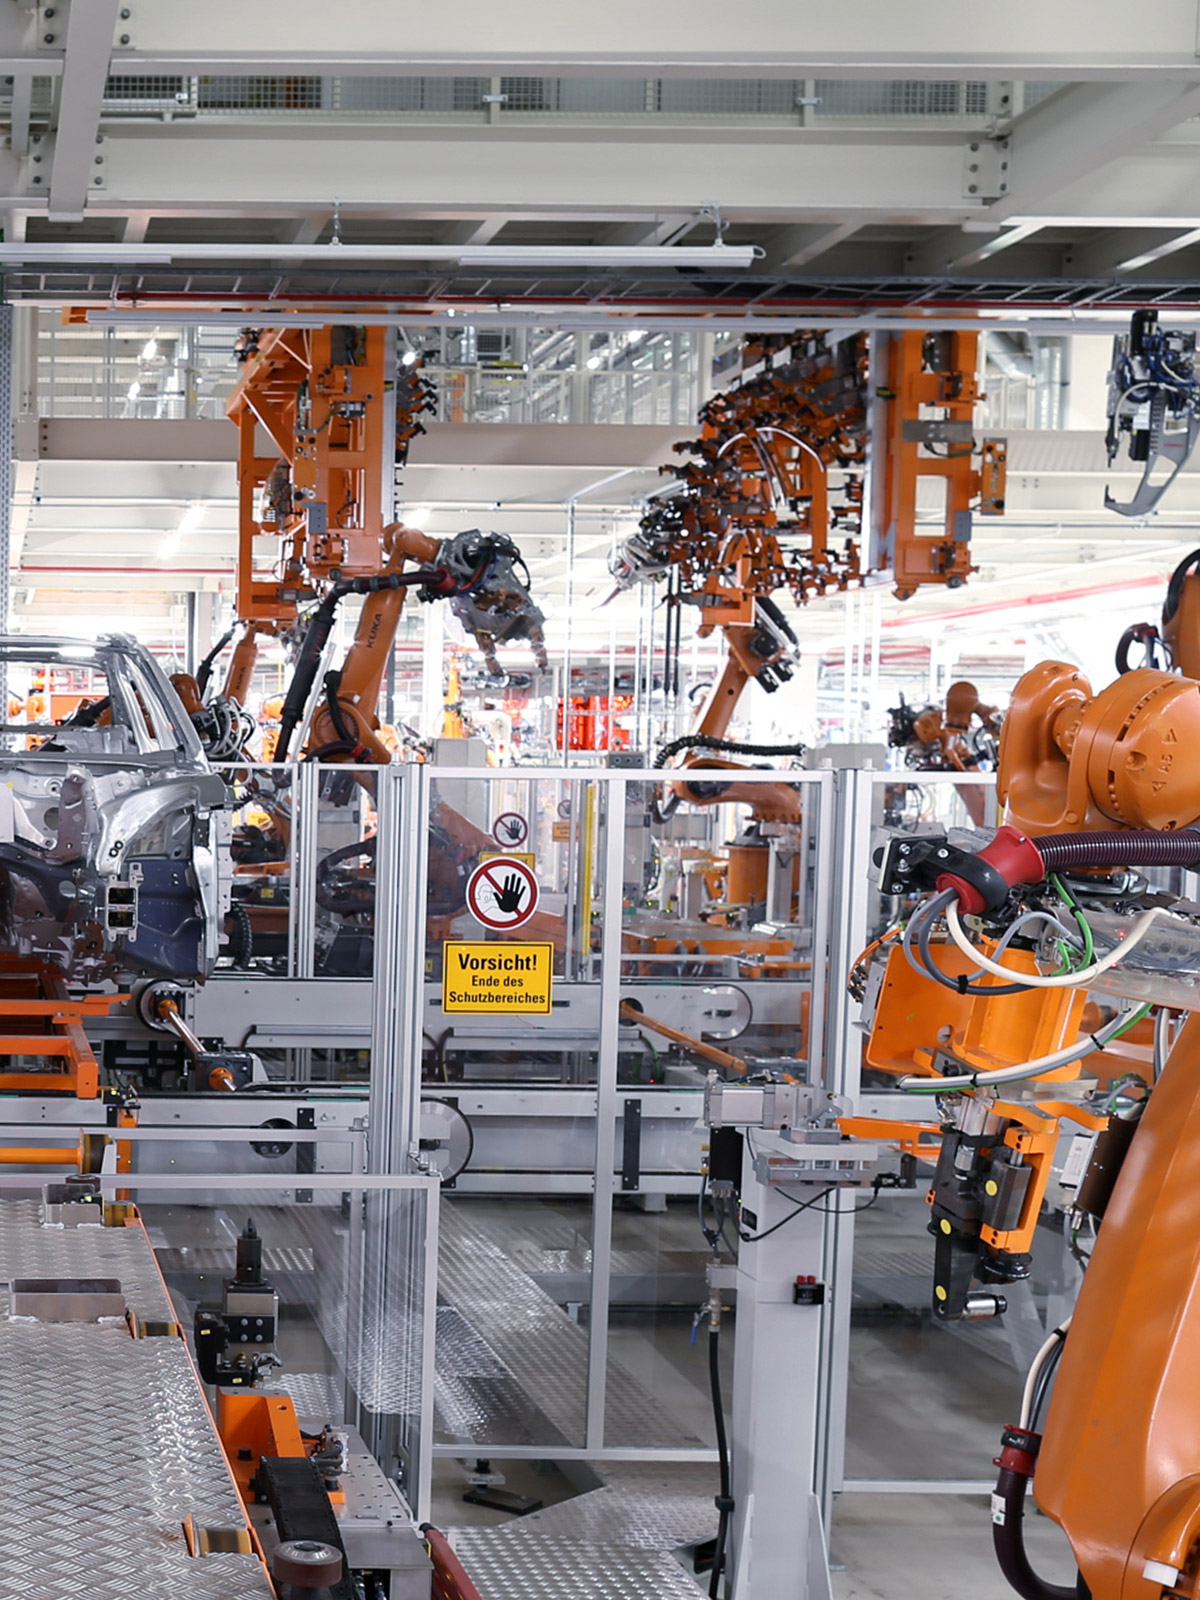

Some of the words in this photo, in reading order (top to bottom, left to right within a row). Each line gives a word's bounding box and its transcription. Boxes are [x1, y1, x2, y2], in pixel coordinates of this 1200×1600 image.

[366, 613, 382, 648] KUKA
[458, 953, 537, 971] Vorsicht!
[471, 975, 500, 987] Ende
[503, 975, 524, 987] des
[449, 991, 546, 1004] Schutzbereiches
